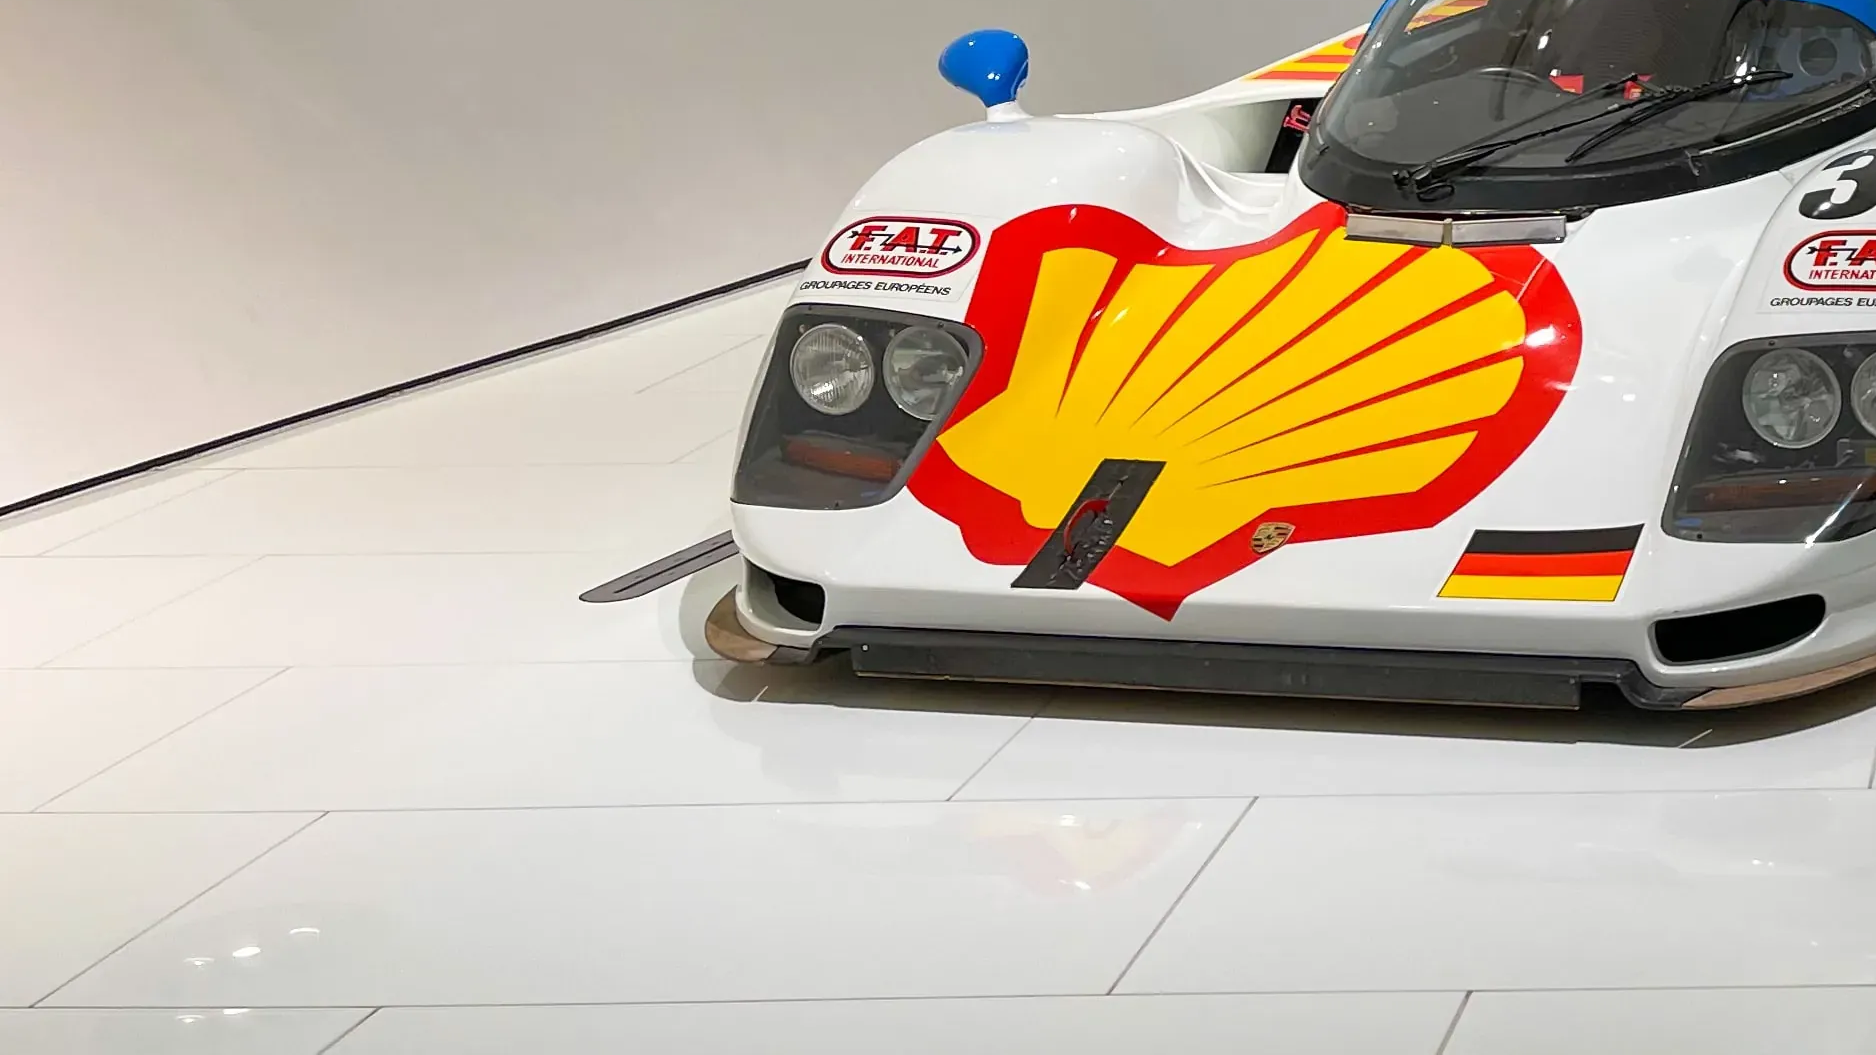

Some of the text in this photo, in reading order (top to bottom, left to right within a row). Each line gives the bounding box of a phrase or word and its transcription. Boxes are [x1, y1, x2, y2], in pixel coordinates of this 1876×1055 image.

[840, 254, 941, 269] INTERNATIONAL
[799, 280, 952, 296] GROUPAGES EUROPÉENS
[1769, 297, 1854, 308] GROUPAGES
